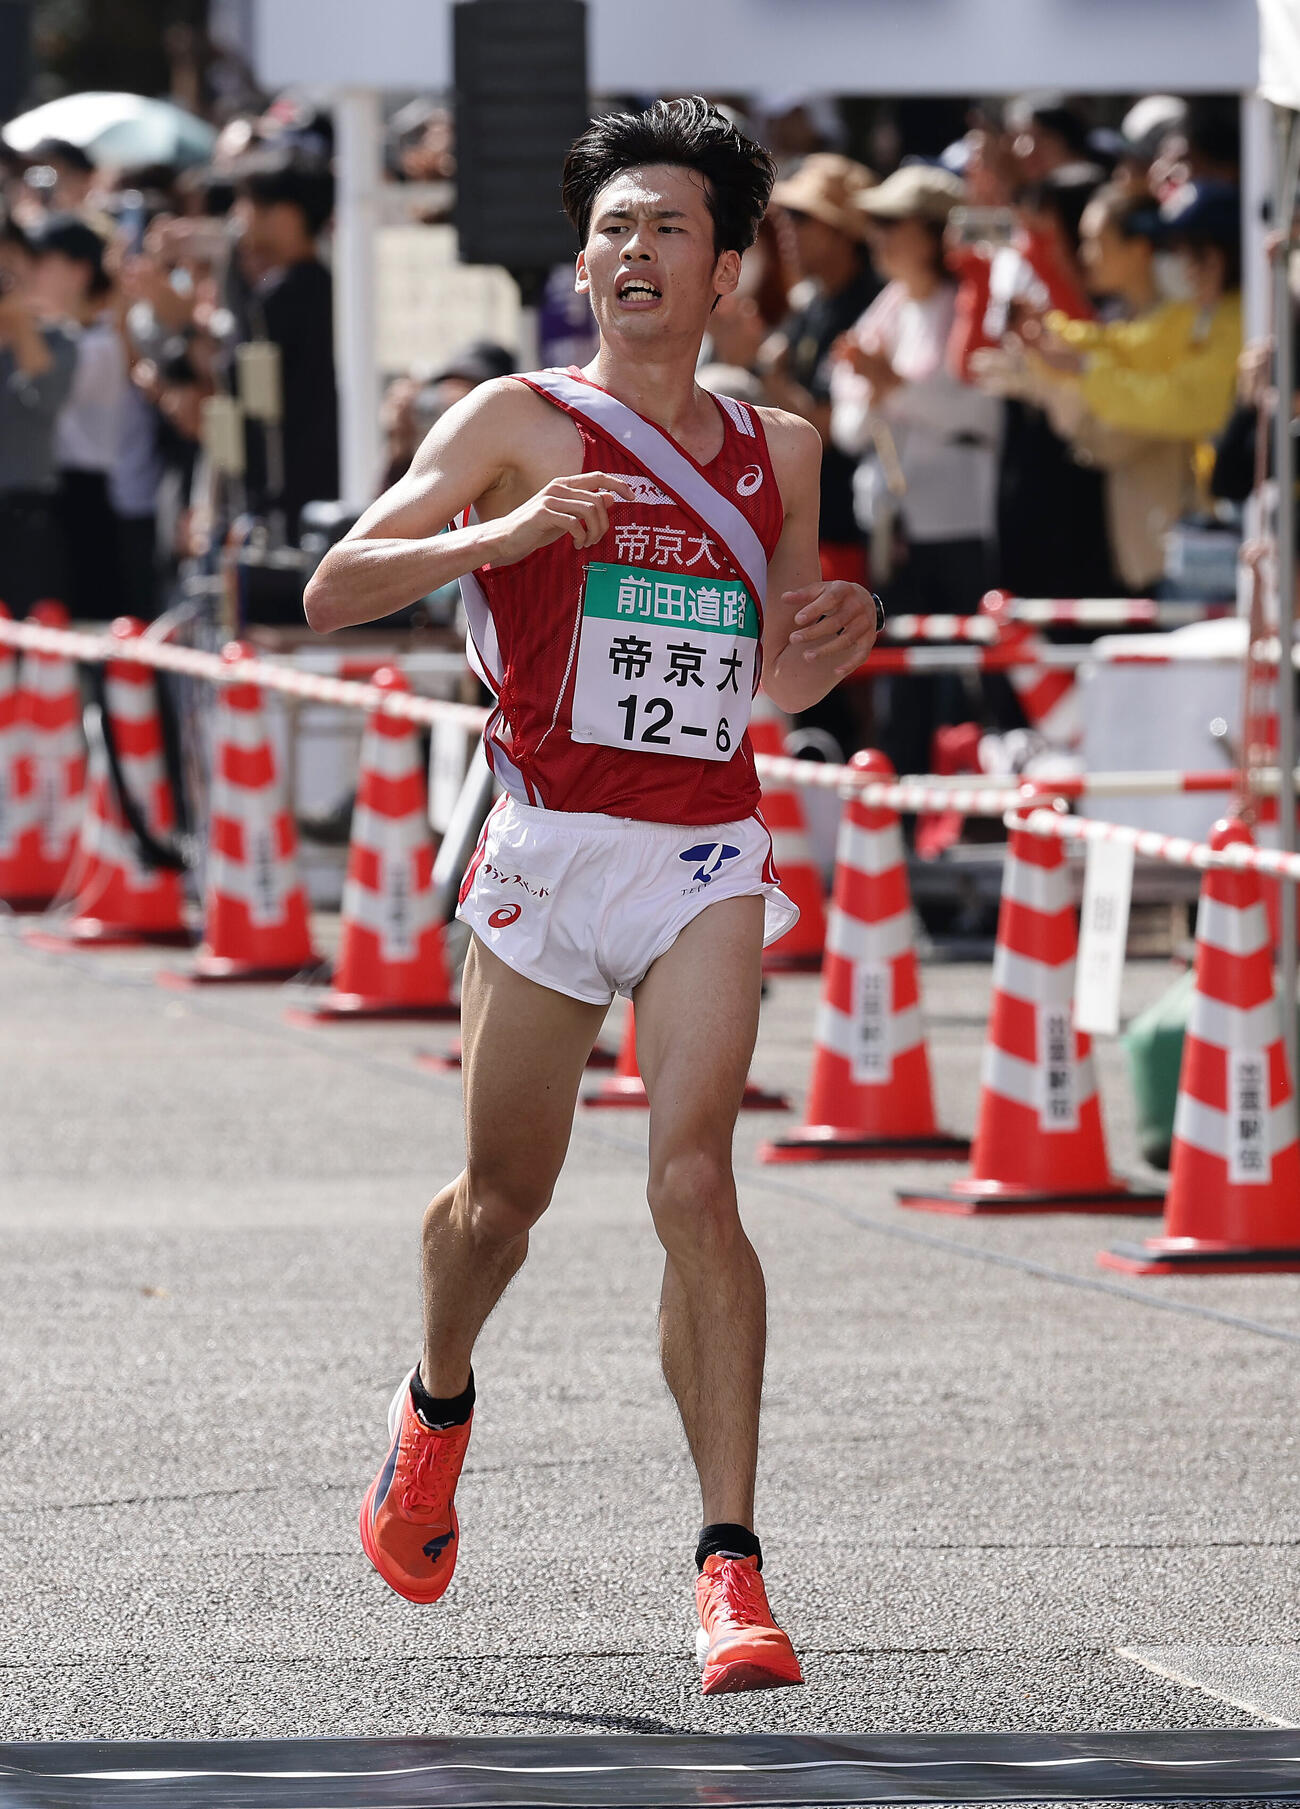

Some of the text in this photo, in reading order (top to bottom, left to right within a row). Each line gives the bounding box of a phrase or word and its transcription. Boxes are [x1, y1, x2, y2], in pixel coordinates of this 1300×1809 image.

[614, 522, 737, 574] 帝京大
[616, 574, 747, 630] 前田道路
[608, 635, 744, 694] 帝京大
[617, 694, 731, 752] 12-6
